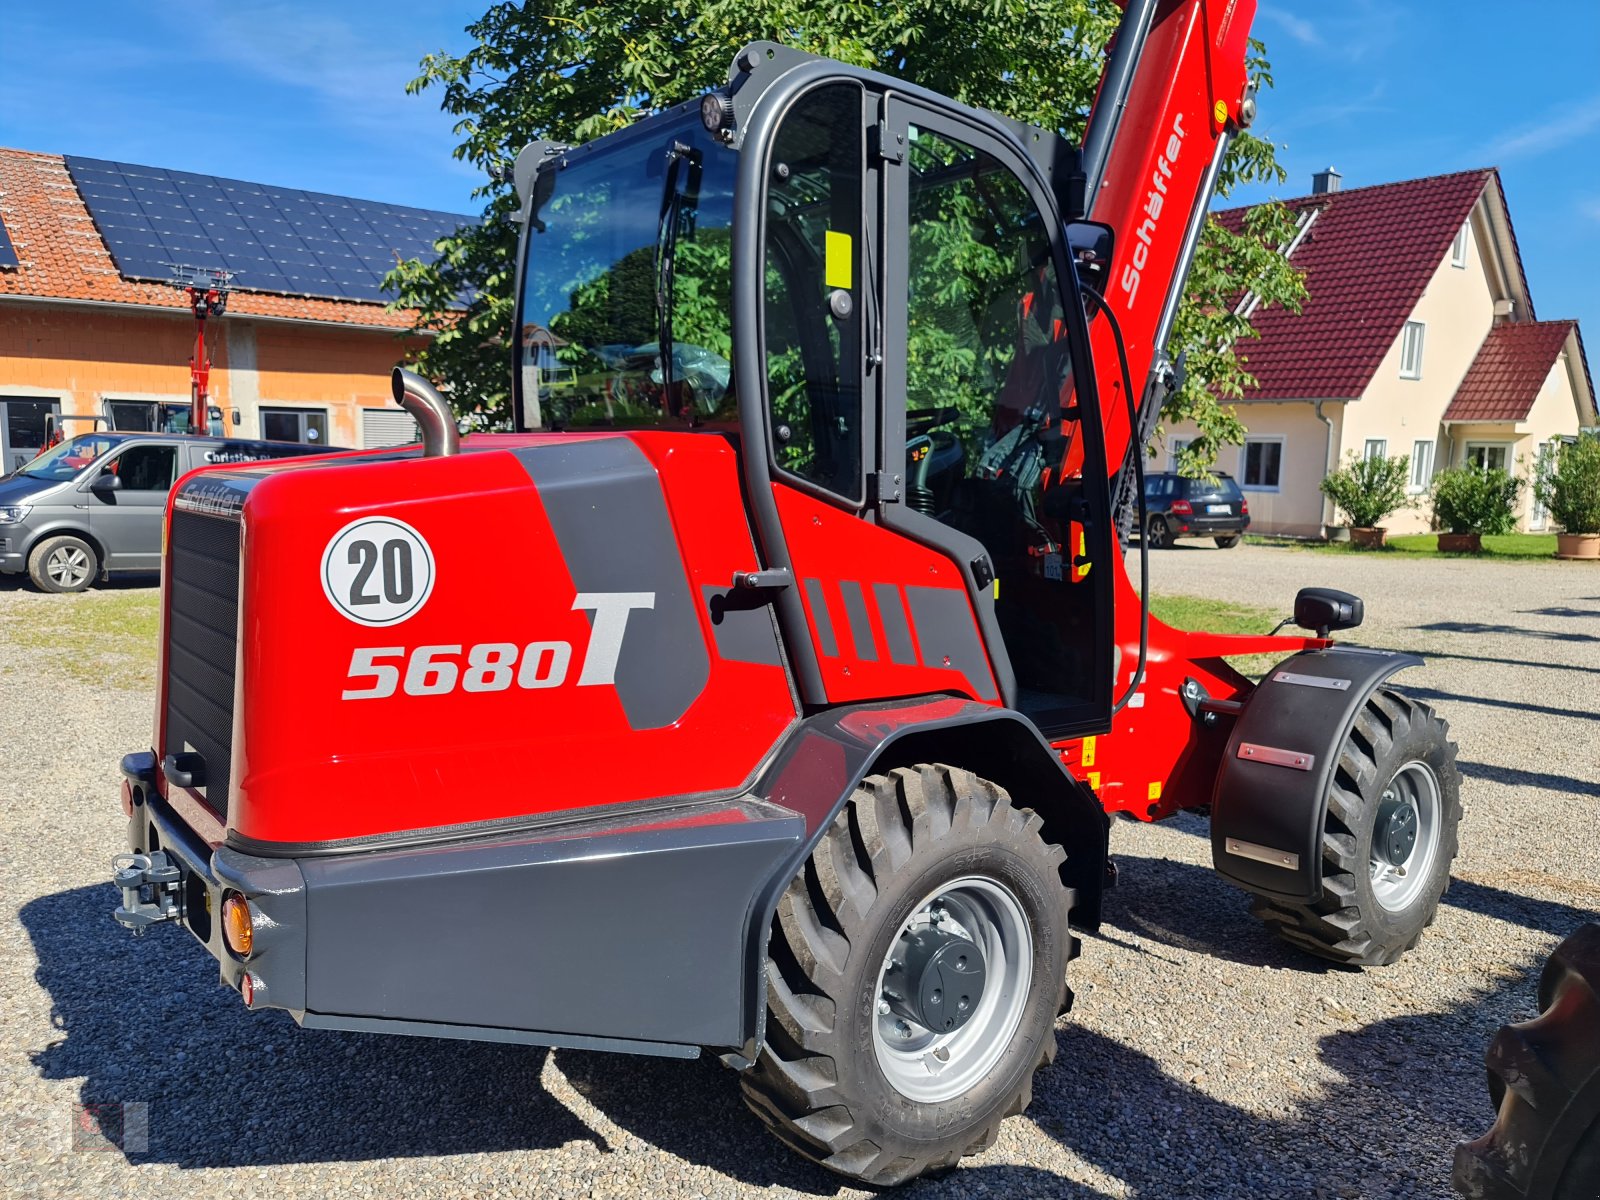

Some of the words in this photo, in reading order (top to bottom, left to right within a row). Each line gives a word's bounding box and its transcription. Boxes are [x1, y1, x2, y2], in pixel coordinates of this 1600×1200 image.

[1121, 112, 1186, 310] Schäffer
[203, 451, 258, 463] Christian
[177, 483, 241, 517] Schäffer
[347, 538, 414, 606] 20
